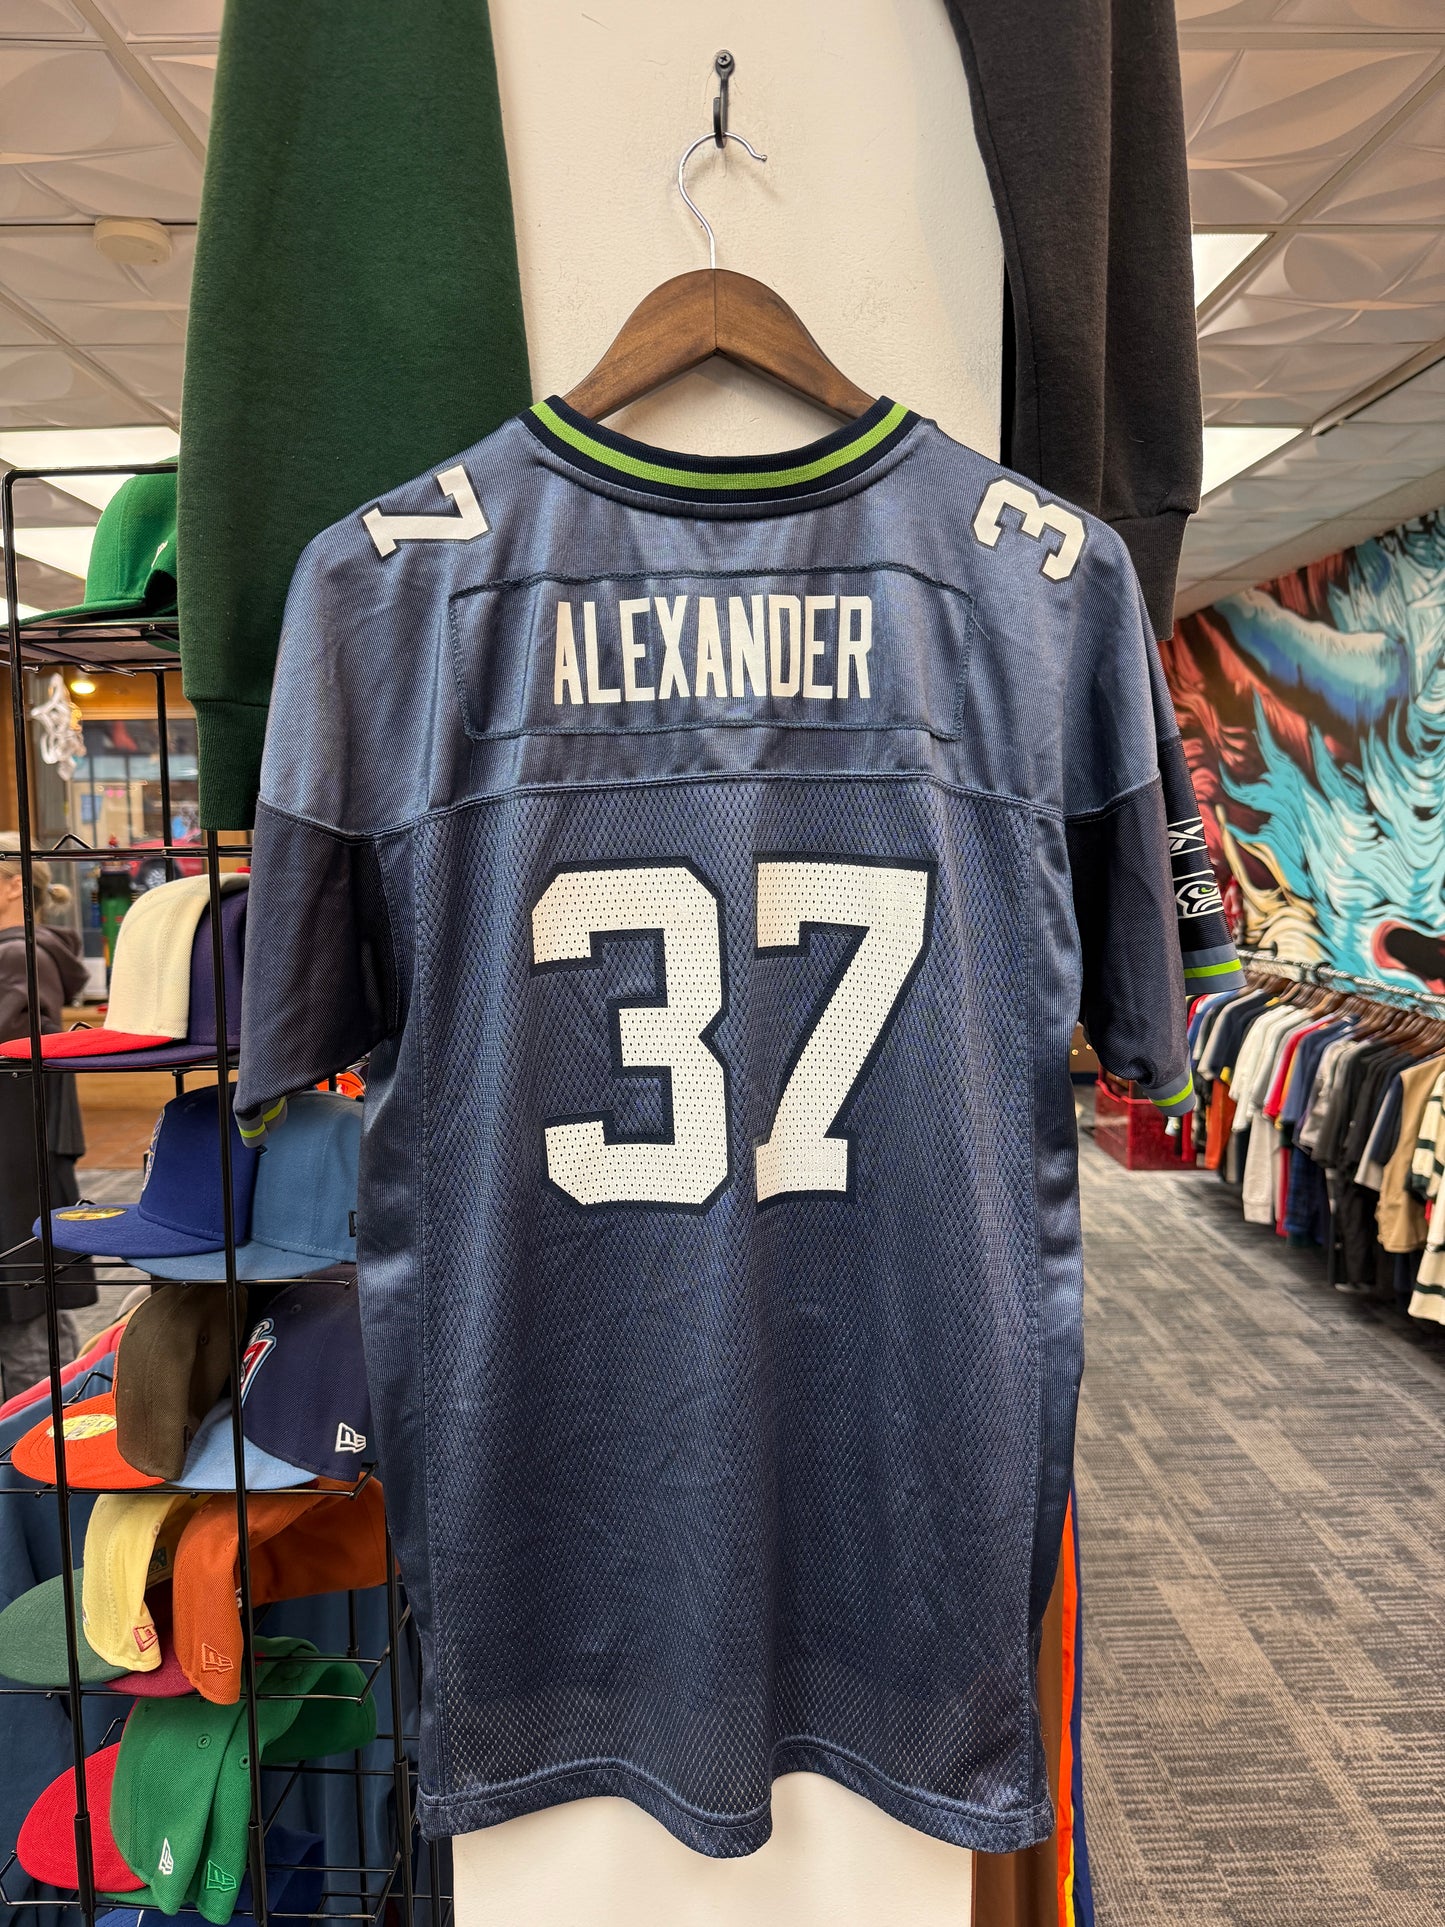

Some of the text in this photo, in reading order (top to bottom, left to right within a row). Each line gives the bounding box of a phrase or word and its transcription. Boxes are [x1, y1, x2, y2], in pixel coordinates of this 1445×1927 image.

[362, 464, 489, 558] 7
[973, 478, 1086, 581] 3
[553, 593, 873, 706] ALEXANDER
[530, 858, 930, 1208] 37
